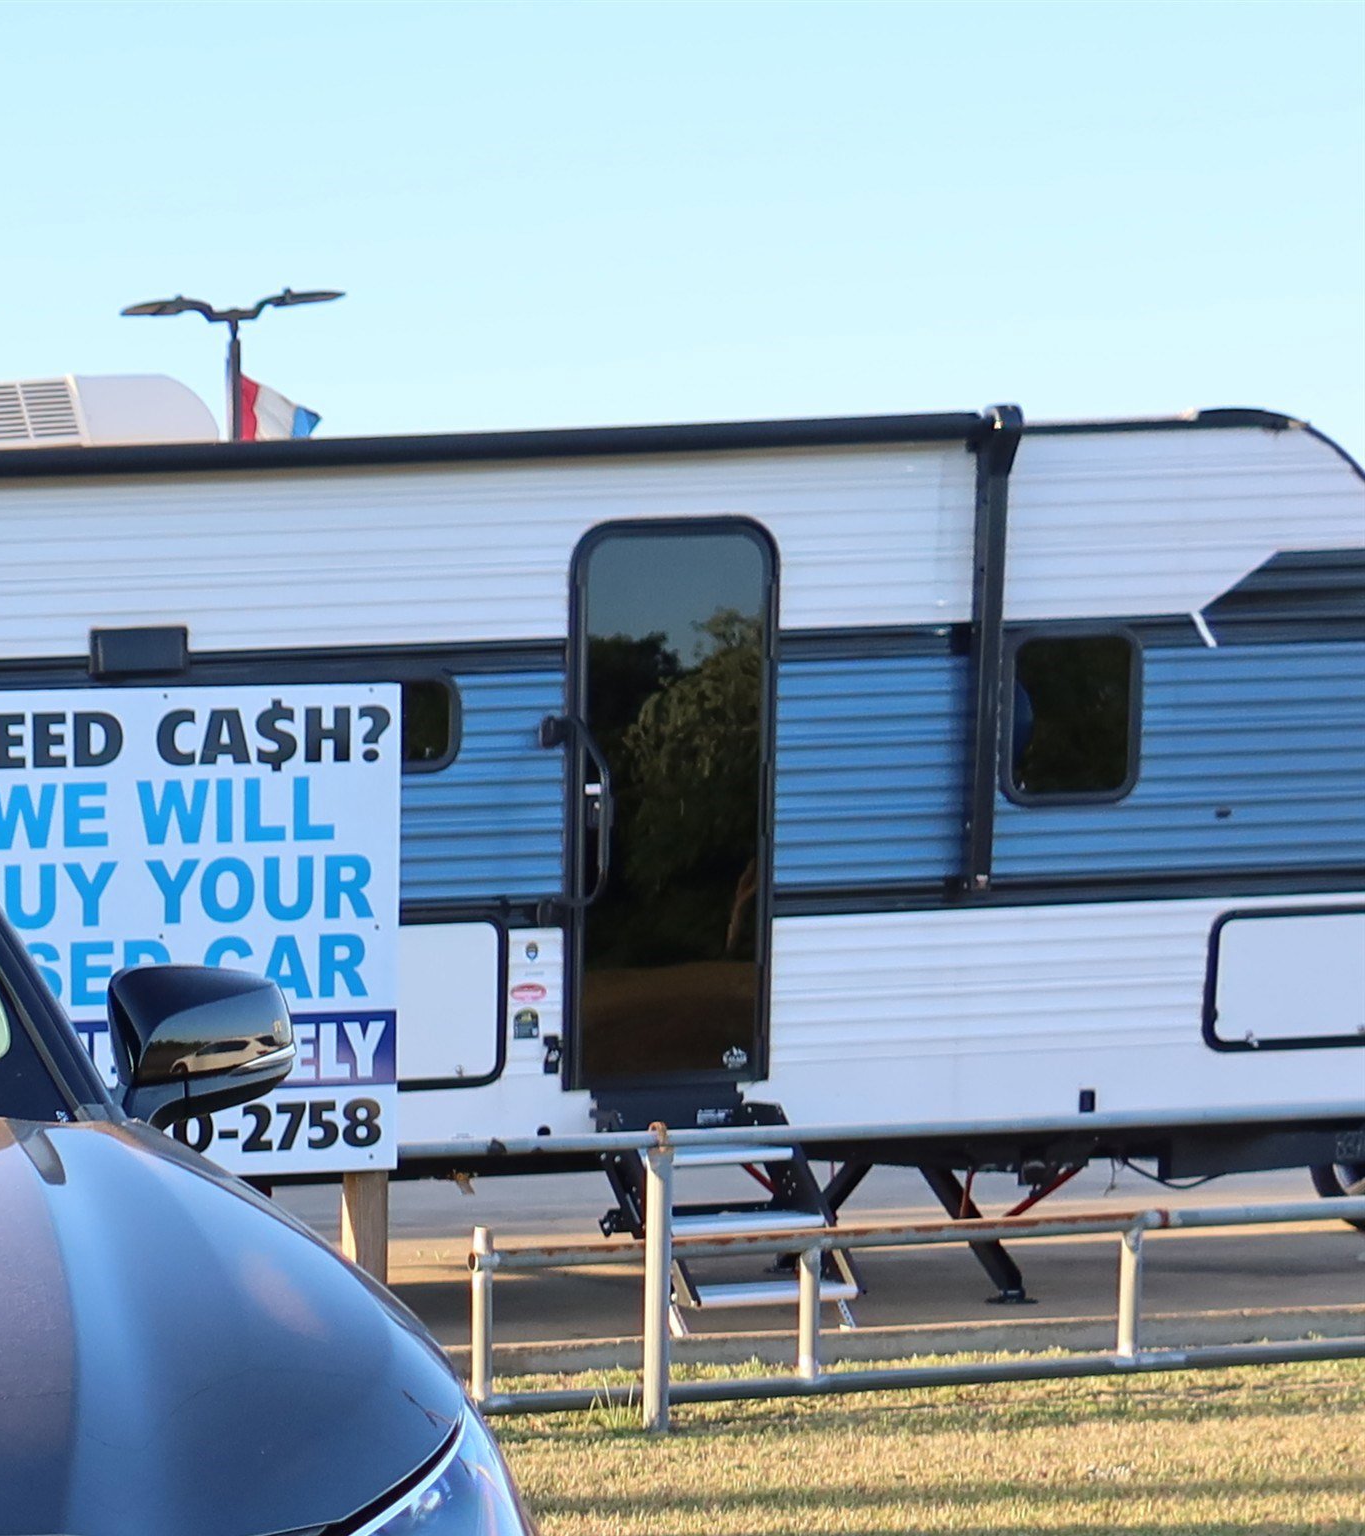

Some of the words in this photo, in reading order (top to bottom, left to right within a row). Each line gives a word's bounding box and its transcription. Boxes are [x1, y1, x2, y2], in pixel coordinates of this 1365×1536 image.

[156, 699, 392, 771] CA$H?
[136, 776, 335, 844] WILL
[145, 854, 375, 924] YOUR
[25, 939, 172, 1006] SE
